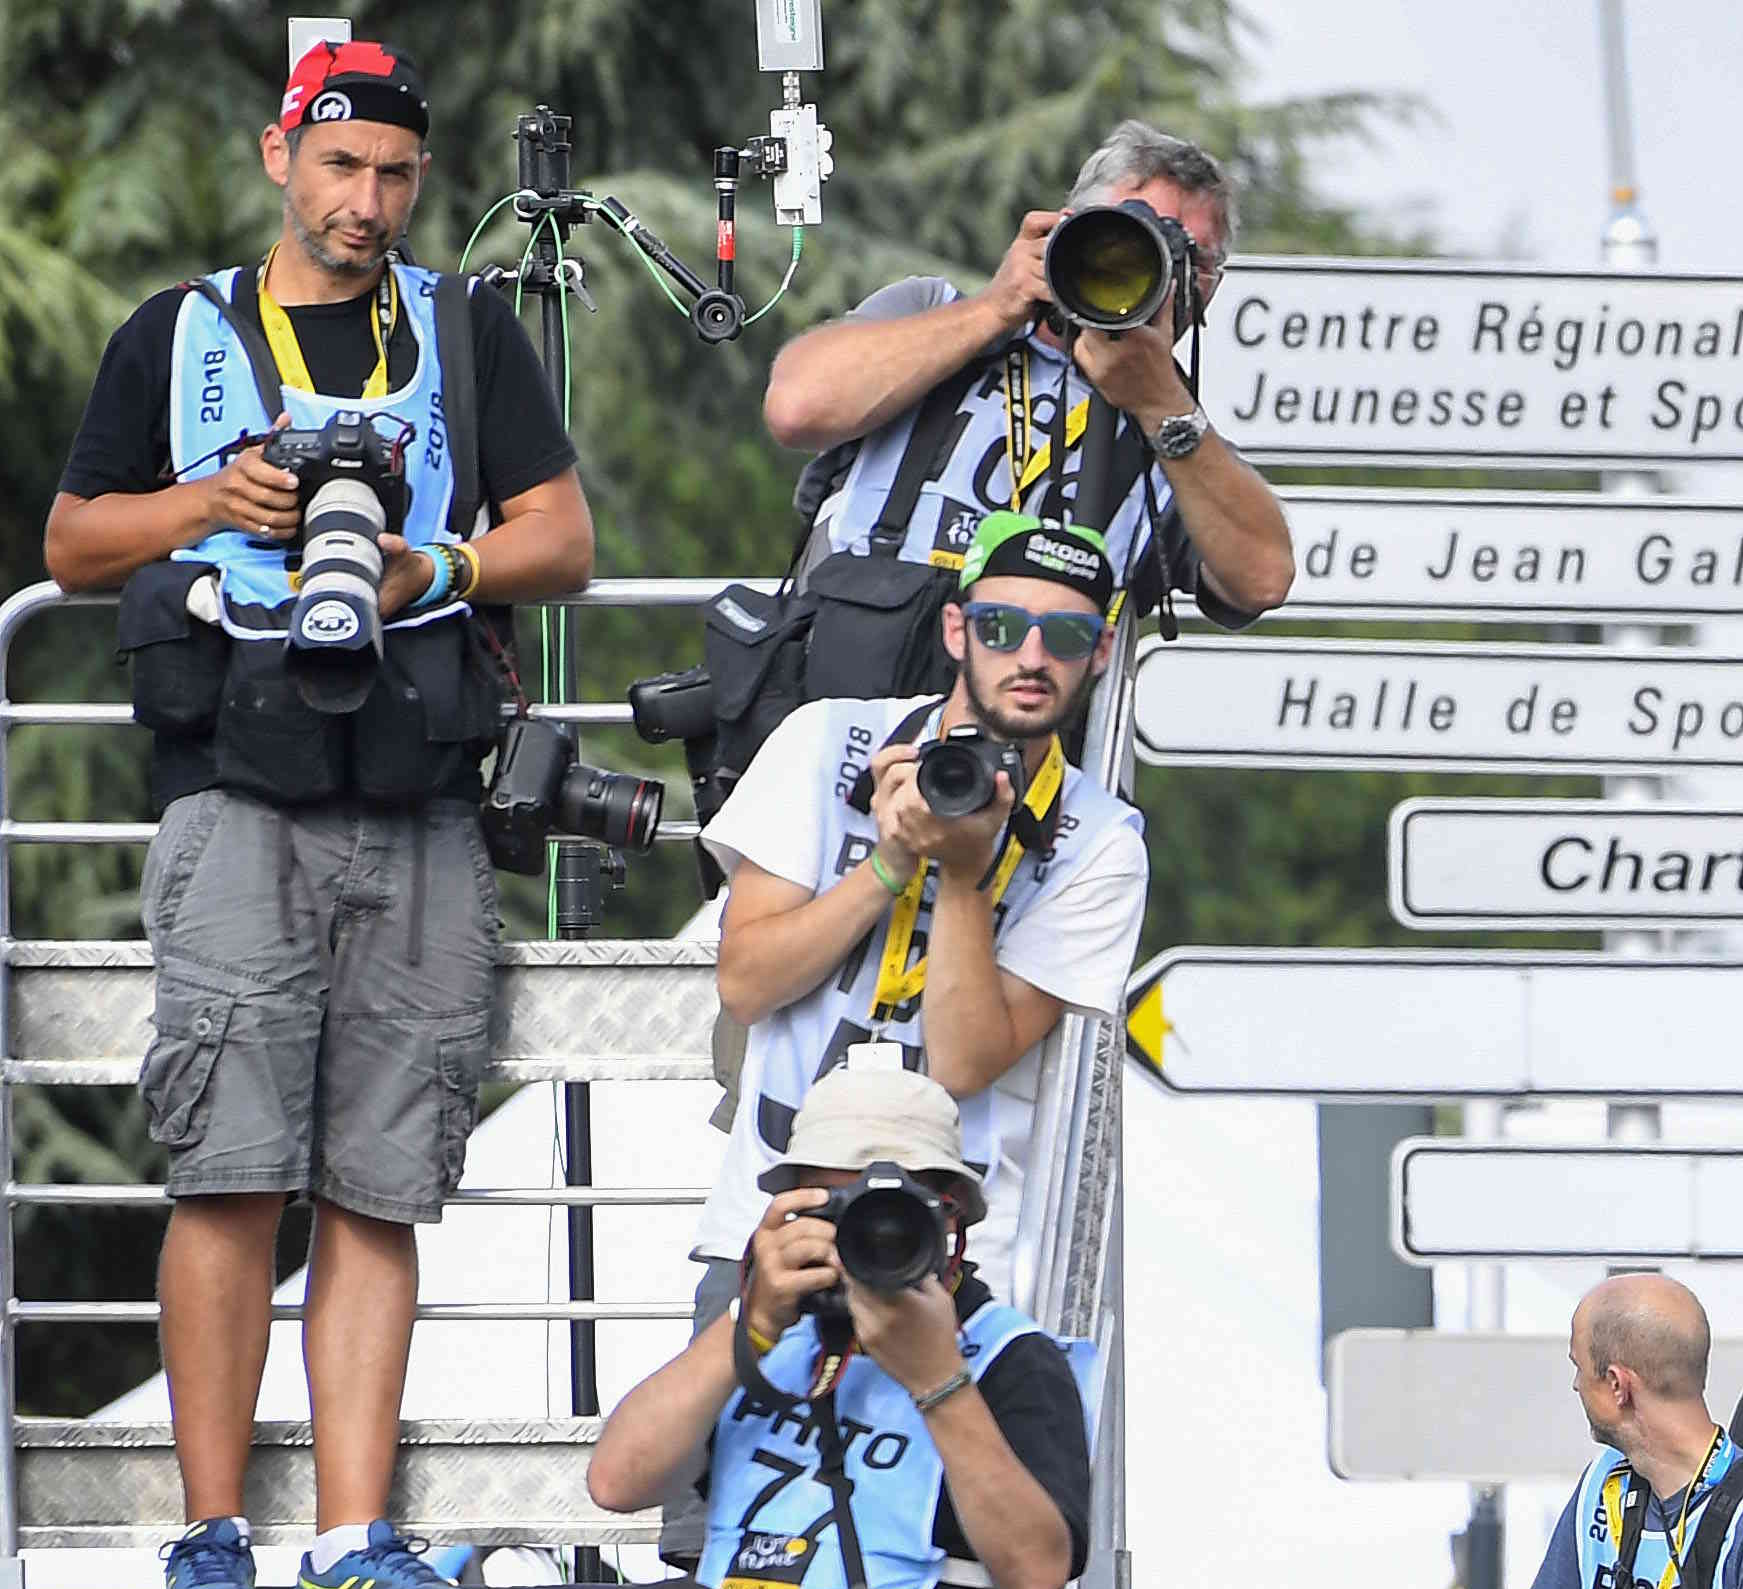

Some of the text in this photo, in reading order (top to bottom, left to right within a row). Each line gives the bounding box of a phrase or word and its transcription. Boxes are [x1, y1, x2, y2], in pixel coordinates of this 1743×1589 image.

[1234, 298, 1439, 351] Centre
[202, 348, 227, 424] 2018
[1233, 373, 1525, 427] Jeunesse
[1560, 386, 1615, 429] et
[1028, 533, 1101, 569] ŠKODA
[1306, 530, 1376, 578] de
[1427, 532, 1585, 582] Jean
[1278, 678, 1456, 729] Halle
[1507, 685, 1577, 734] de
[835, 725, 873, 800] 2018
